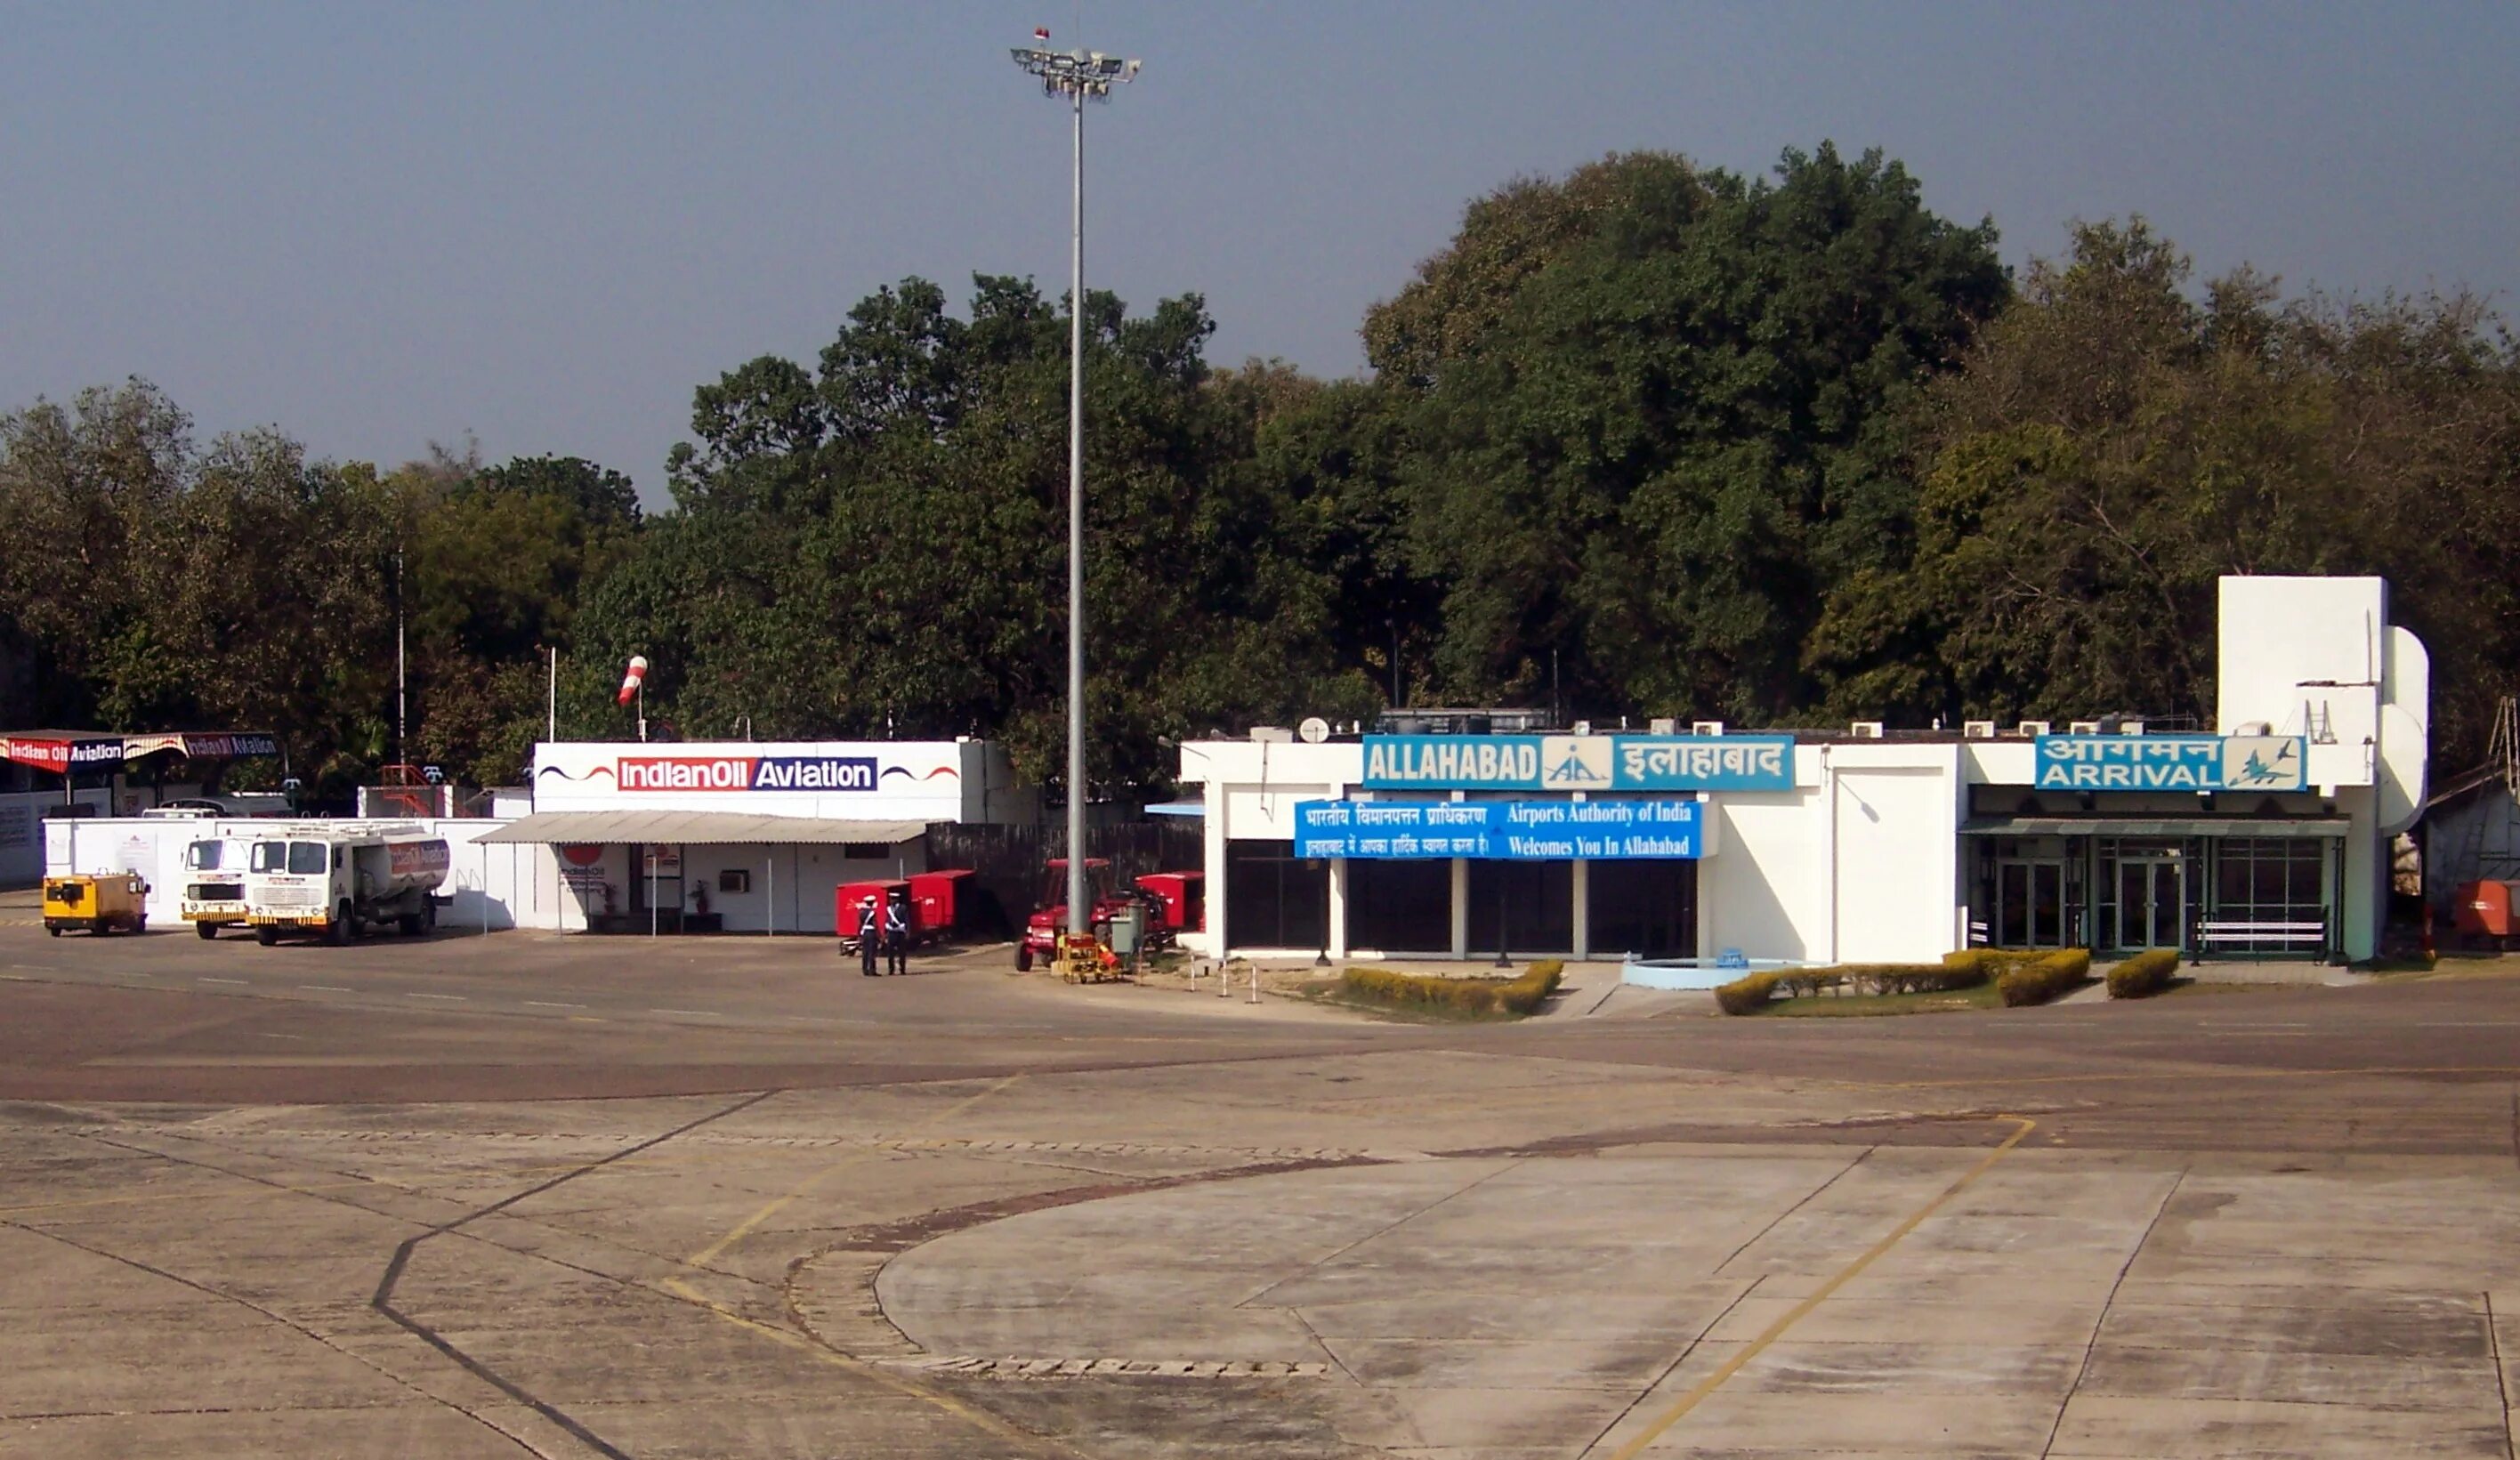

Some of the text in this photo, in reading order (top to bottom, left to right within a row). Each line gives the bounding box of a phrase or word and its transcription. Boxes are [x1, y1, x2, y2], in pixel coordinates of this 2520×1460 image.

[11, 743, 121, 762] Indian Oil Aviation
[1368, 744, 1537, 780] ALLAHABAD
[1620, 743, 1785, 780] इलाहाबाद
[2043, 739, 2222, 762] आगमन
[622, 761, 871, 787] IndianOil Aviation
[2042, 764, 2221, 786] ARRIVAL
[1305, 802, 1488, 827] भारतीय विमानपत्तन प्राधिकरण
[1507, 803, 1691, 827] Airports Authority of India
[1348, 833, 1356, 853] में
[1360, 839, 1388, 854] आपका
[1391, 833, 1418, 856] हार्दिक
[1422, 839, 1448, 854] स्वागत
[1451, 839, 1474, 853] करता
[1509, 836, 1689, 856] Welcomes You In Allahabad
